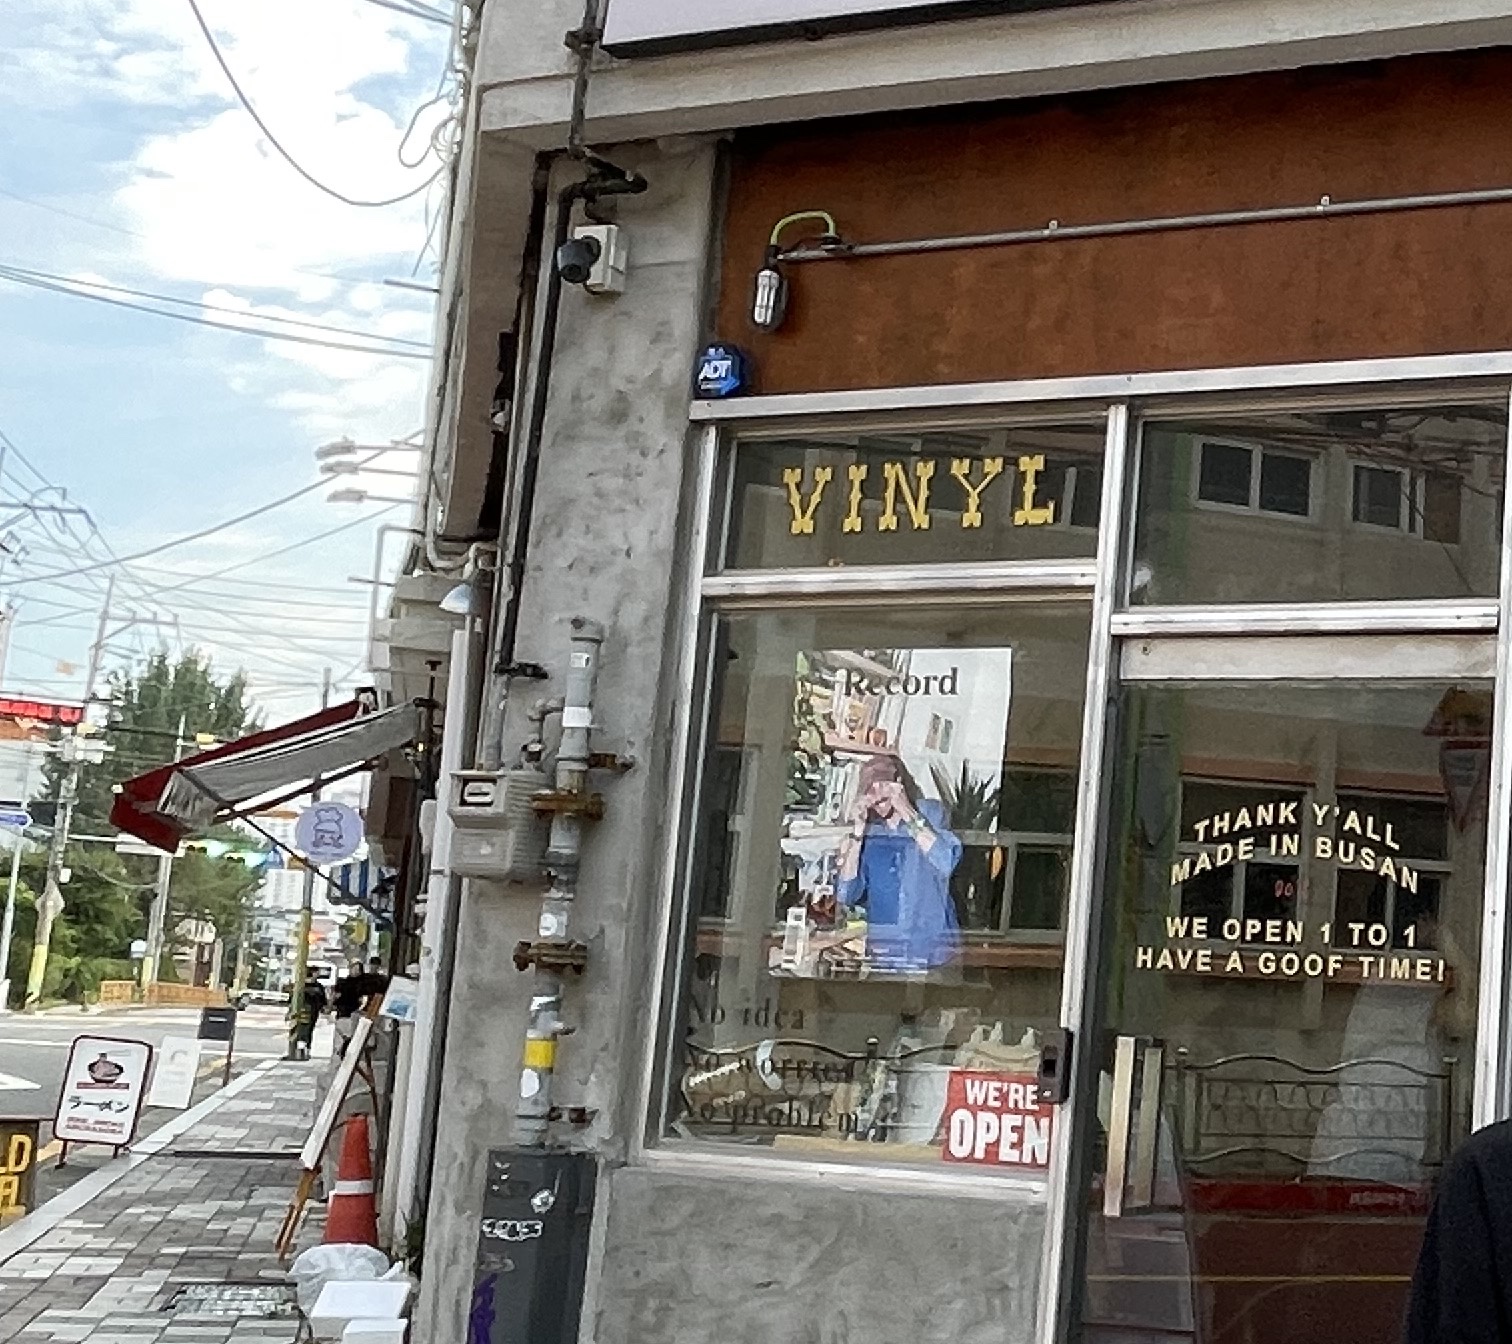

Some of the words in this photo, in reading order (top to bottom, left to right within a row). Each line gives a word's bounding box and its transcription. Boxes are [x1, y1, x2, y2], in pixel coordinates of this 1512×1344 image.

[699, 360, 732, 380] ADT
[782, 454, 1055, 535] VINYL
[843, 666, 959, 697] Record
[1192, 801, 1298, 844] THANK
[1313, 802, 1401, 851] Y'ALL
[1170, 836, 1255, 887] MADE
[1270, 834, 1299, 857] IN
[1315, 836, 1419, 895] BUSAN
[1166, 916, 1208, 939] WE
[1222, 919, 1304, 943] OPEN
[1320, 921, 1332, 944] 1
[1348, 922, 1389, 948] TO
[1402, 924, 1416, 948] 1
[1136, 946, 1213, 973] HAVE
[1225, 950, 1244, 974] A
[1258, 952, 1344, 977] GOOF
[1357, 956, 1446, 983] TIME!
[742, 996, 806, 1031] idea
[964, 1078, 1040, 1111] WE'RE
[948, 1108, 1050, 1166] OPEN
